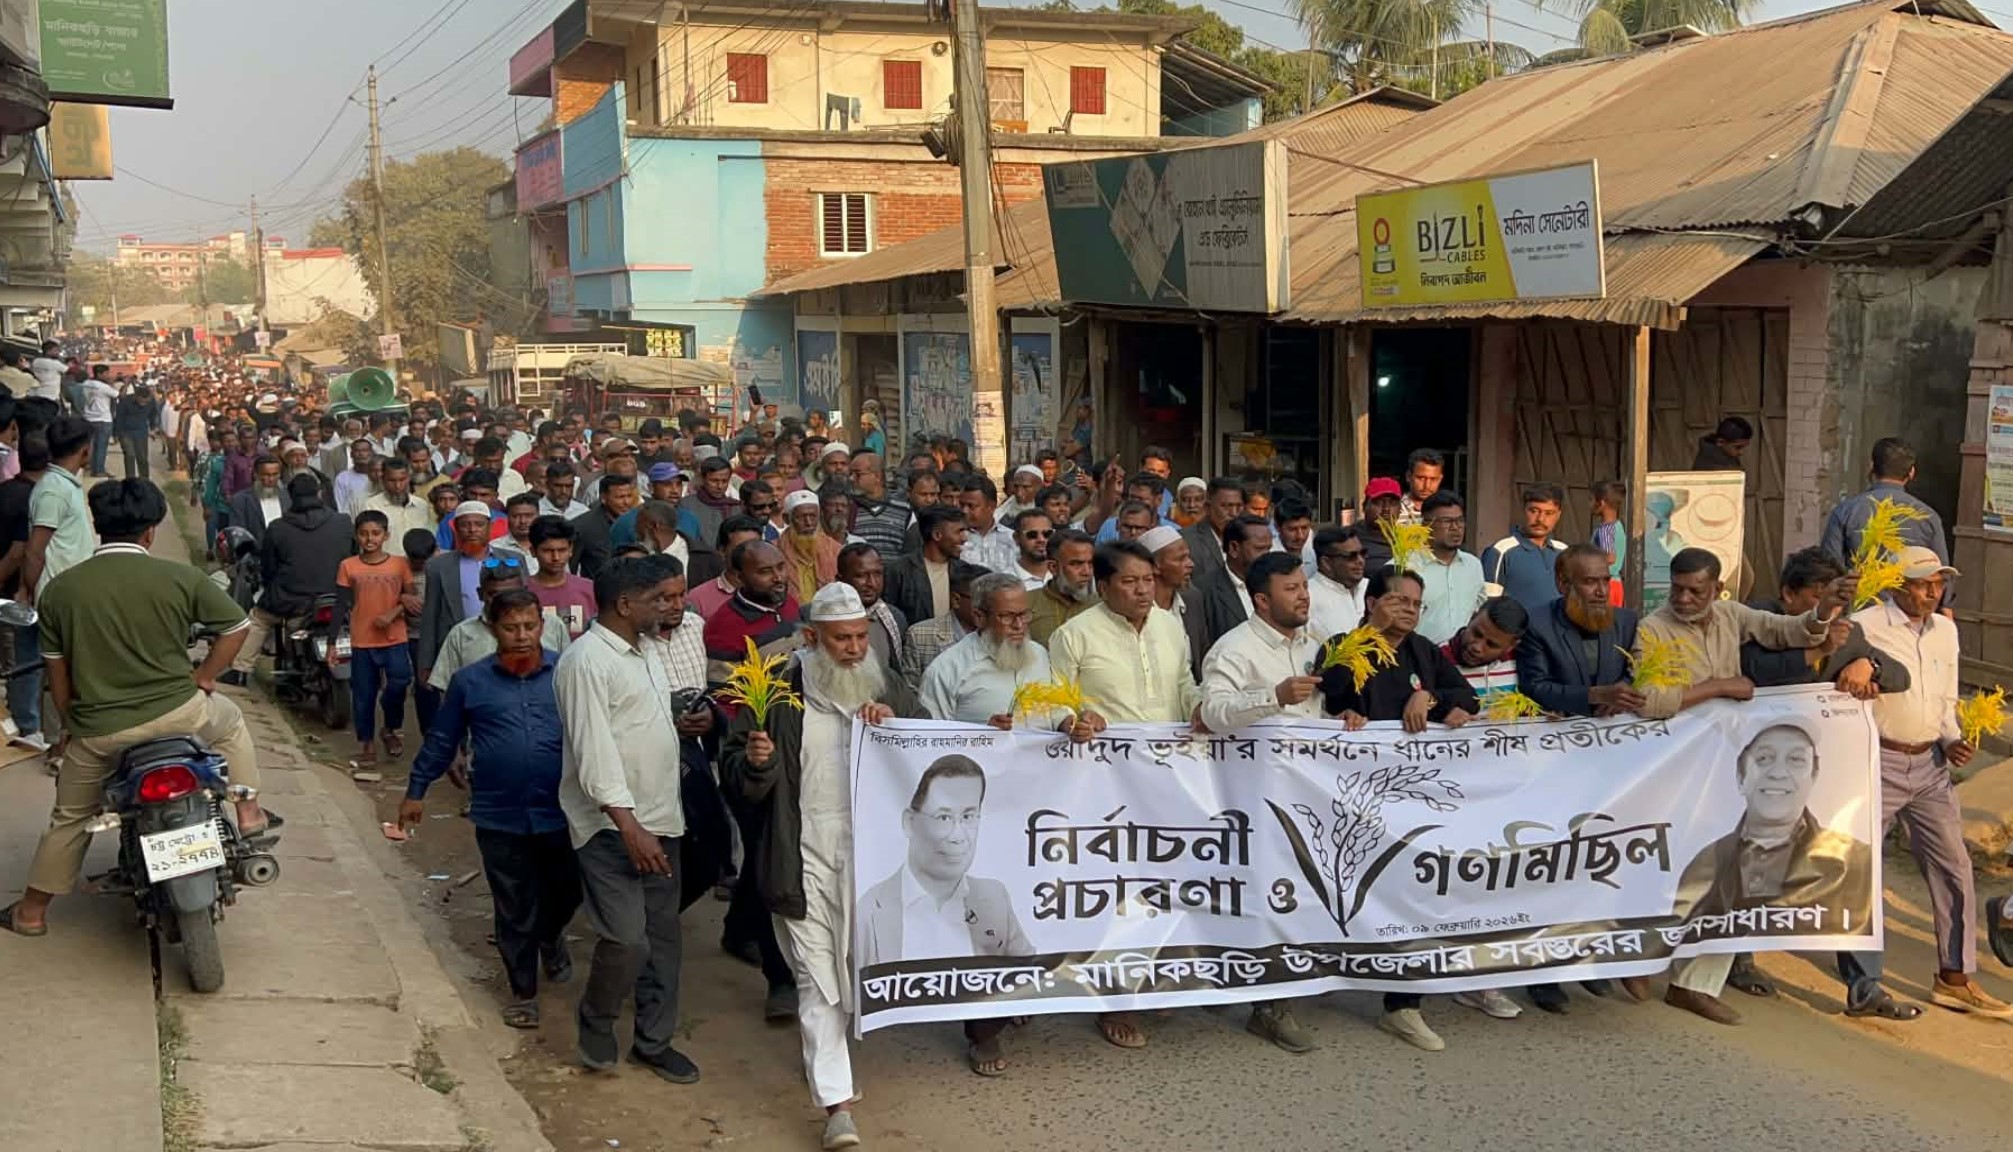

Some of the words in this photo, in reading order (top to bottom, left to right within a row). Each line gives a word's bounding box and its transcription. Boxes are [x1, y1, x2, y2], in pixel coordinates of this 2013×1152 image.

[1503, 209, 1535, 236] মদিনা
[1539, 201, 1589, 234] সেনেটারী
[1447, 250, 1485, 263] CABLES
[970, 735, 995, 748] রাহিম
[1267, 733, 1381, 762] সমর্থনে
[1394, 738, 1472, 762] ধানের
[1478, 728, 1529, 757] শীষ
[1540, 718, 1671, 753] প্রতীকের
[1025, 805, 1254, 867] নির্বাচনী
[1413, 812, 1672, 896] গণমিছিল
[1033, 874, 1247, 920] প্রচারণা
[1267, 877, 1298, 914] ও
[863, 966, 1056, 1002] আয়োজনে:
[1067, 951, 1273, 989] মানিকছড়ি
[1281, 944, 1475, 977] উপজেলার
[1483, 927, 1647, 966] সর্বস্তরের
